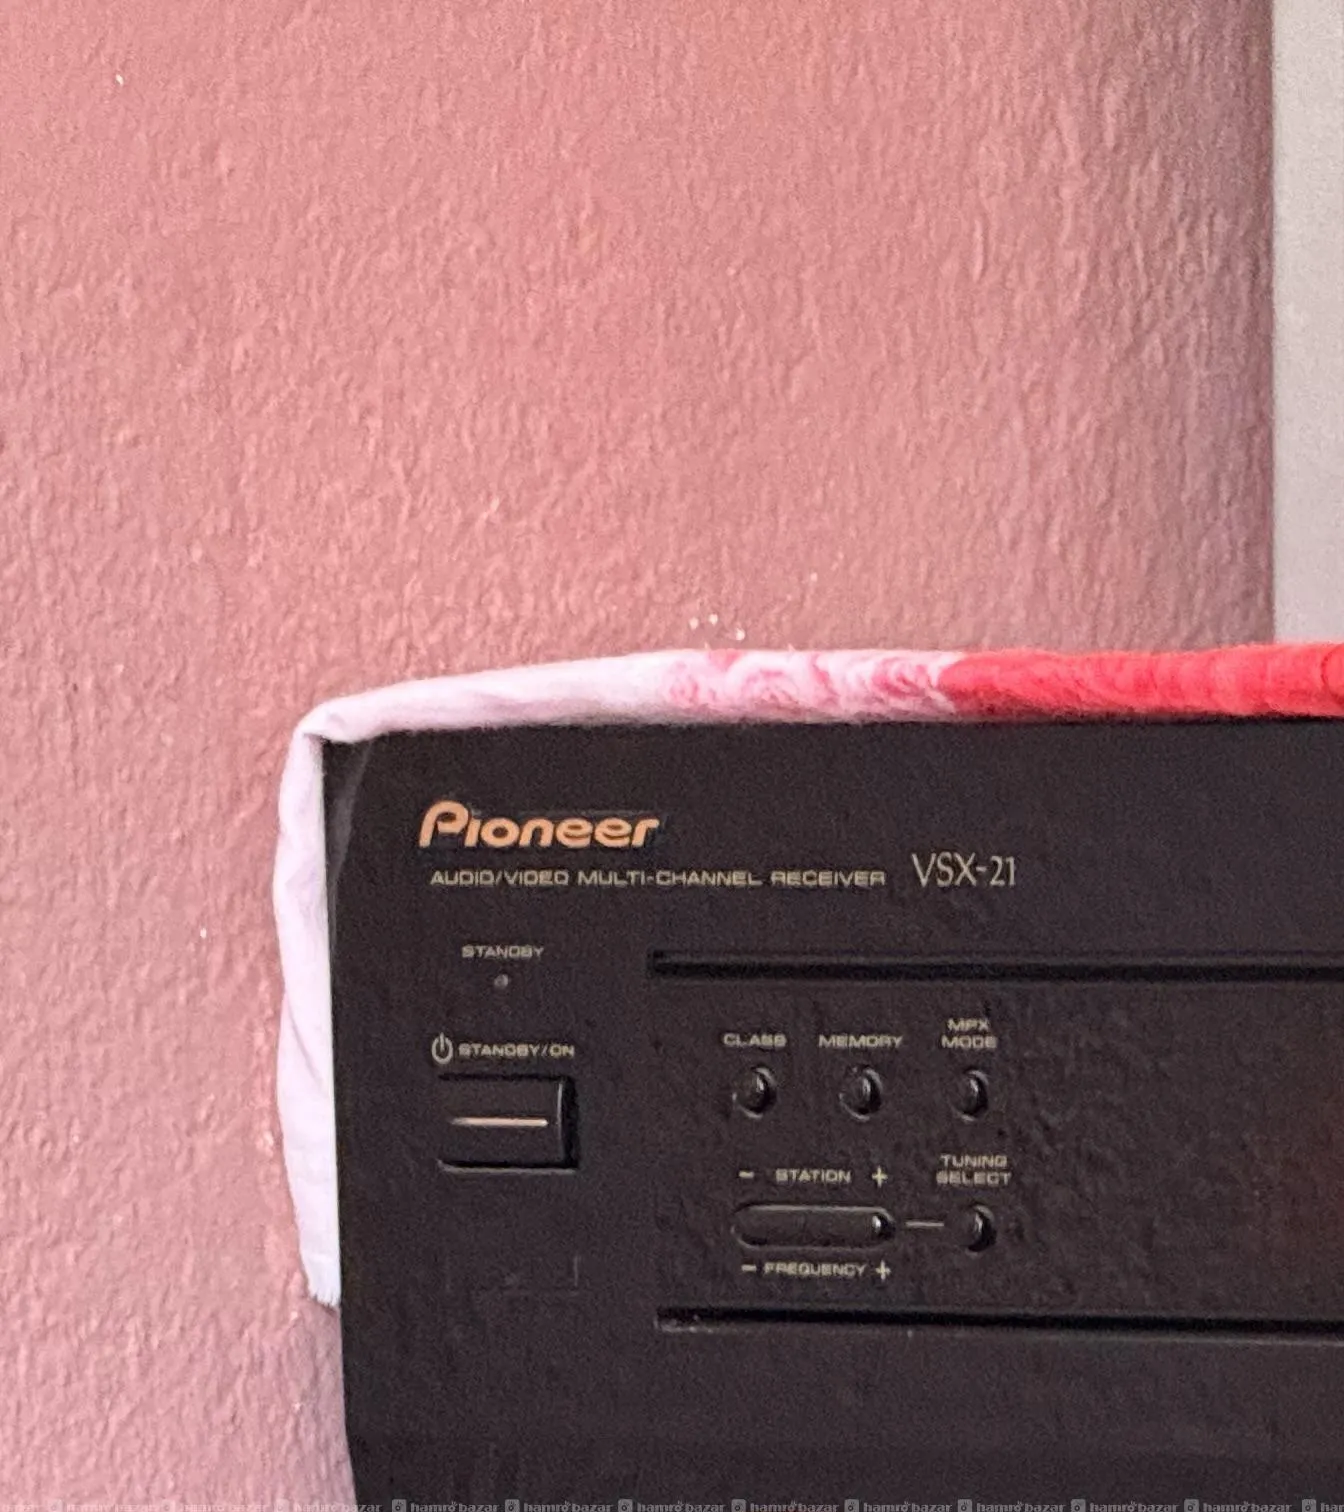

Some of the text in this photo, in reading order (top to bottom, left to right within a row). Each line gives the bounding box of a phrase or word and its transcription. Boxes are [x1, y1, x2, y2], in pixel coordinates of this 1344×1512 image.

[419, 800, 660, 849] Pioneer
[429, 851, 1016, 888] AUDIO/VIDEO MULTI-CHANNEL RECEIVER VSX-21
[461, 944, 545, 959] STANDBY
[947, 1017, 989, 1032] MPX
[723, 1033, 787, 1048] CLASS
[818, 1034, 903, 1049] MEMORY
[941, 1034, 997, 1050] MODE
[458, 1043, 575, 1058] STANDBY/ON
[939, 1154, 1008, 1169] TUNING
[775, 1168, 851, 1184] STATION
[936, 1170, 1012, 1185] SELECT
[763, 1261, 867, 1278] FREQUENCY
